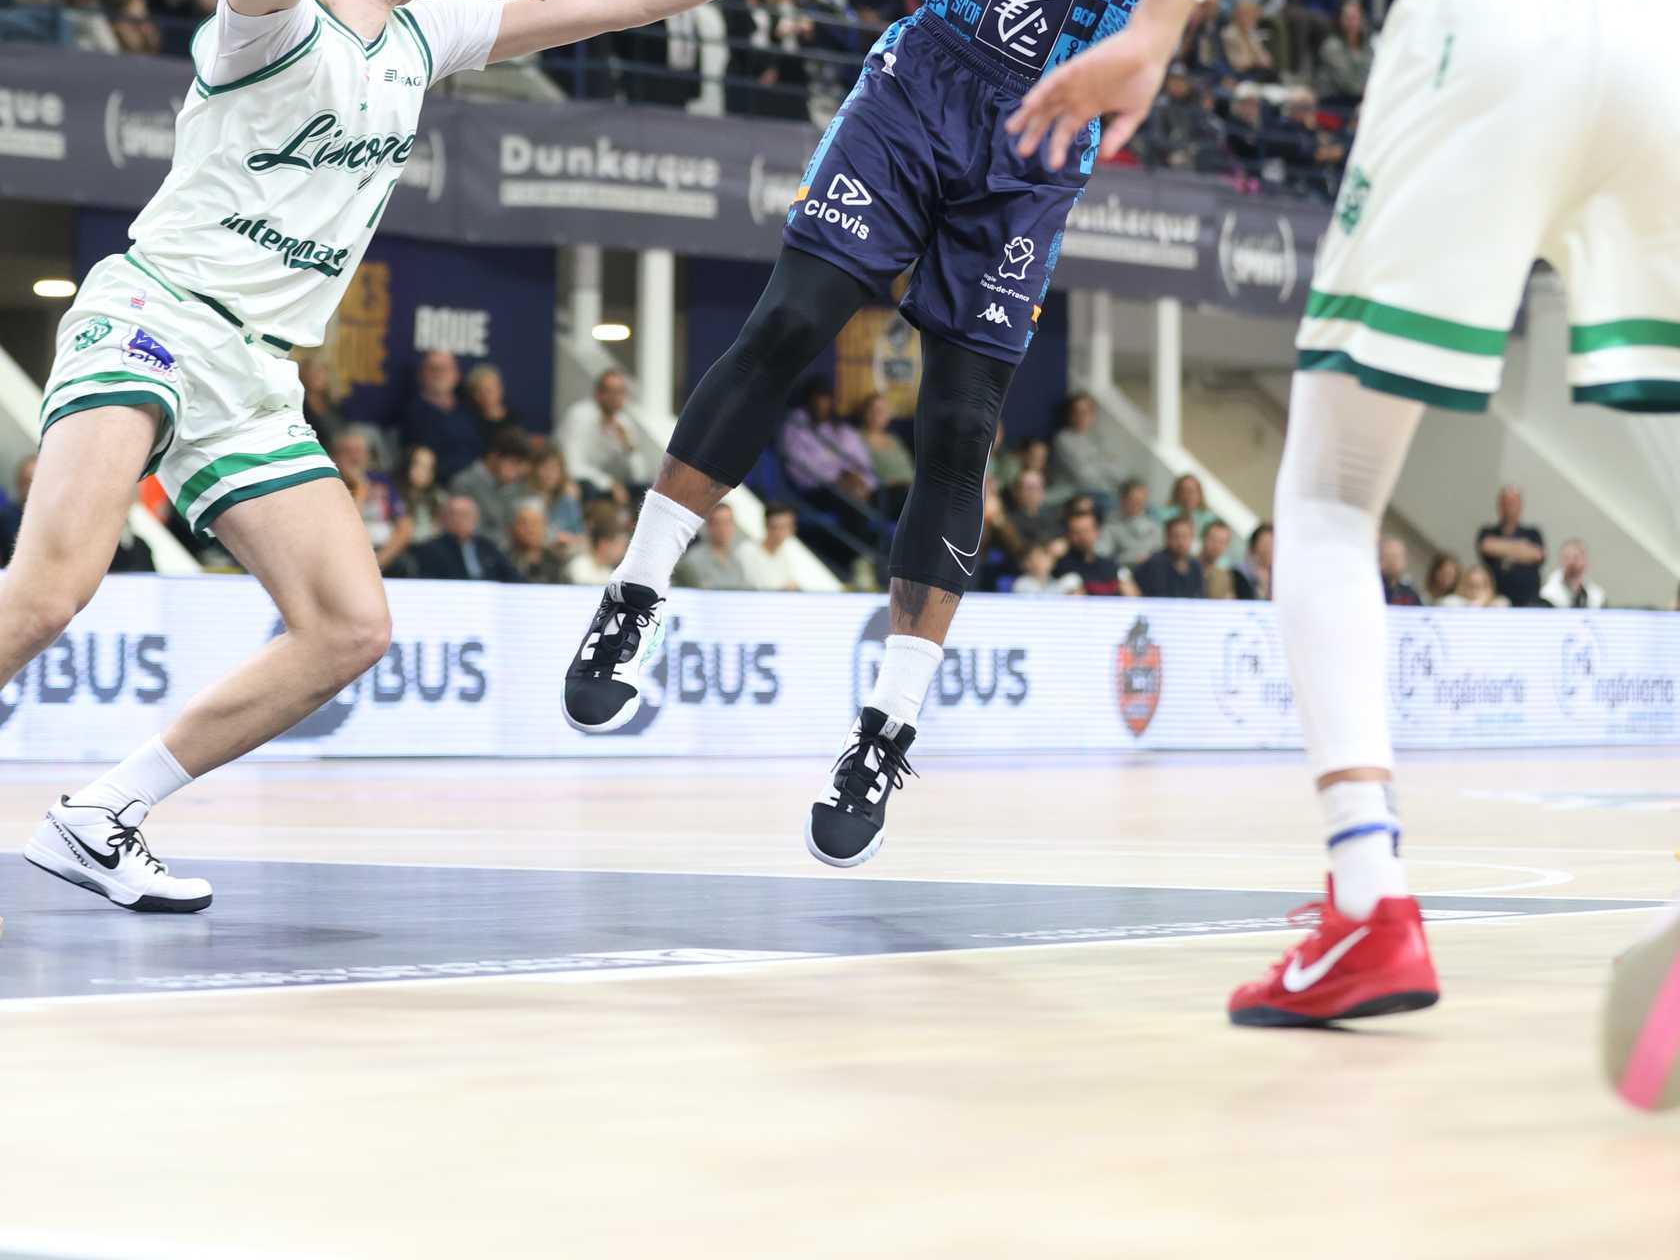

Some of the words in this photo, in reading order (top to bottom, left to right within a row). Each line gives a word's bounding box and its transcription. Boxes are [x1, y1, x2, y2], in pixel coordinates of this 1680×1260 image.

[502, 135, 719, 188] Dunkerque
[804, 200, 870, 240] Clovis
[1067, 195, 1198, 244] unkerque
